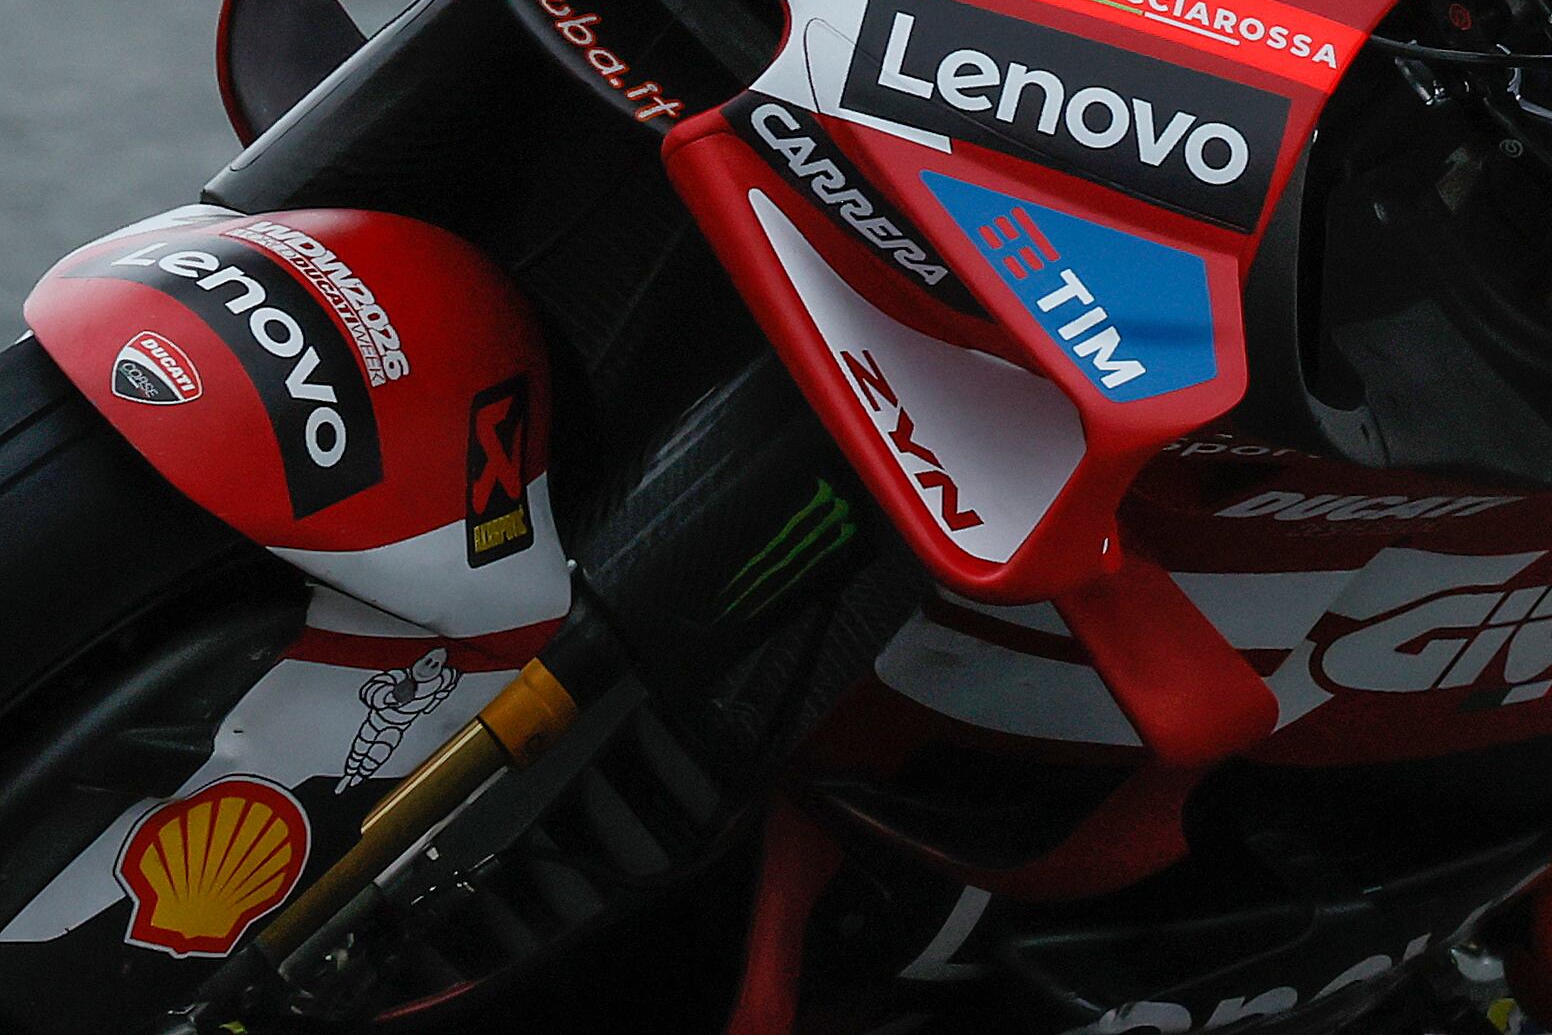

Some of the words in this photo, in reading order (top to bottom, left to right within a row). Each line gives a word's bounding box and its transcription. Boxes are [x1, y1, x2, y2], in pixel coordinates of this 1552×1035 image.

[878, 10, 1249, 186] Lenovo
[749, 103, 953, 287] CARRERA
[110, 241, 347, 469] Lenovo
[139, 337, 197, 394] DUCATI
[247, 219, 411, 382] WDW2026
[1036, 267, 1147, 390] TIM
[838, 349, 985, 533] ZYN
[1212, 490, 1529, 522] DUCATI
